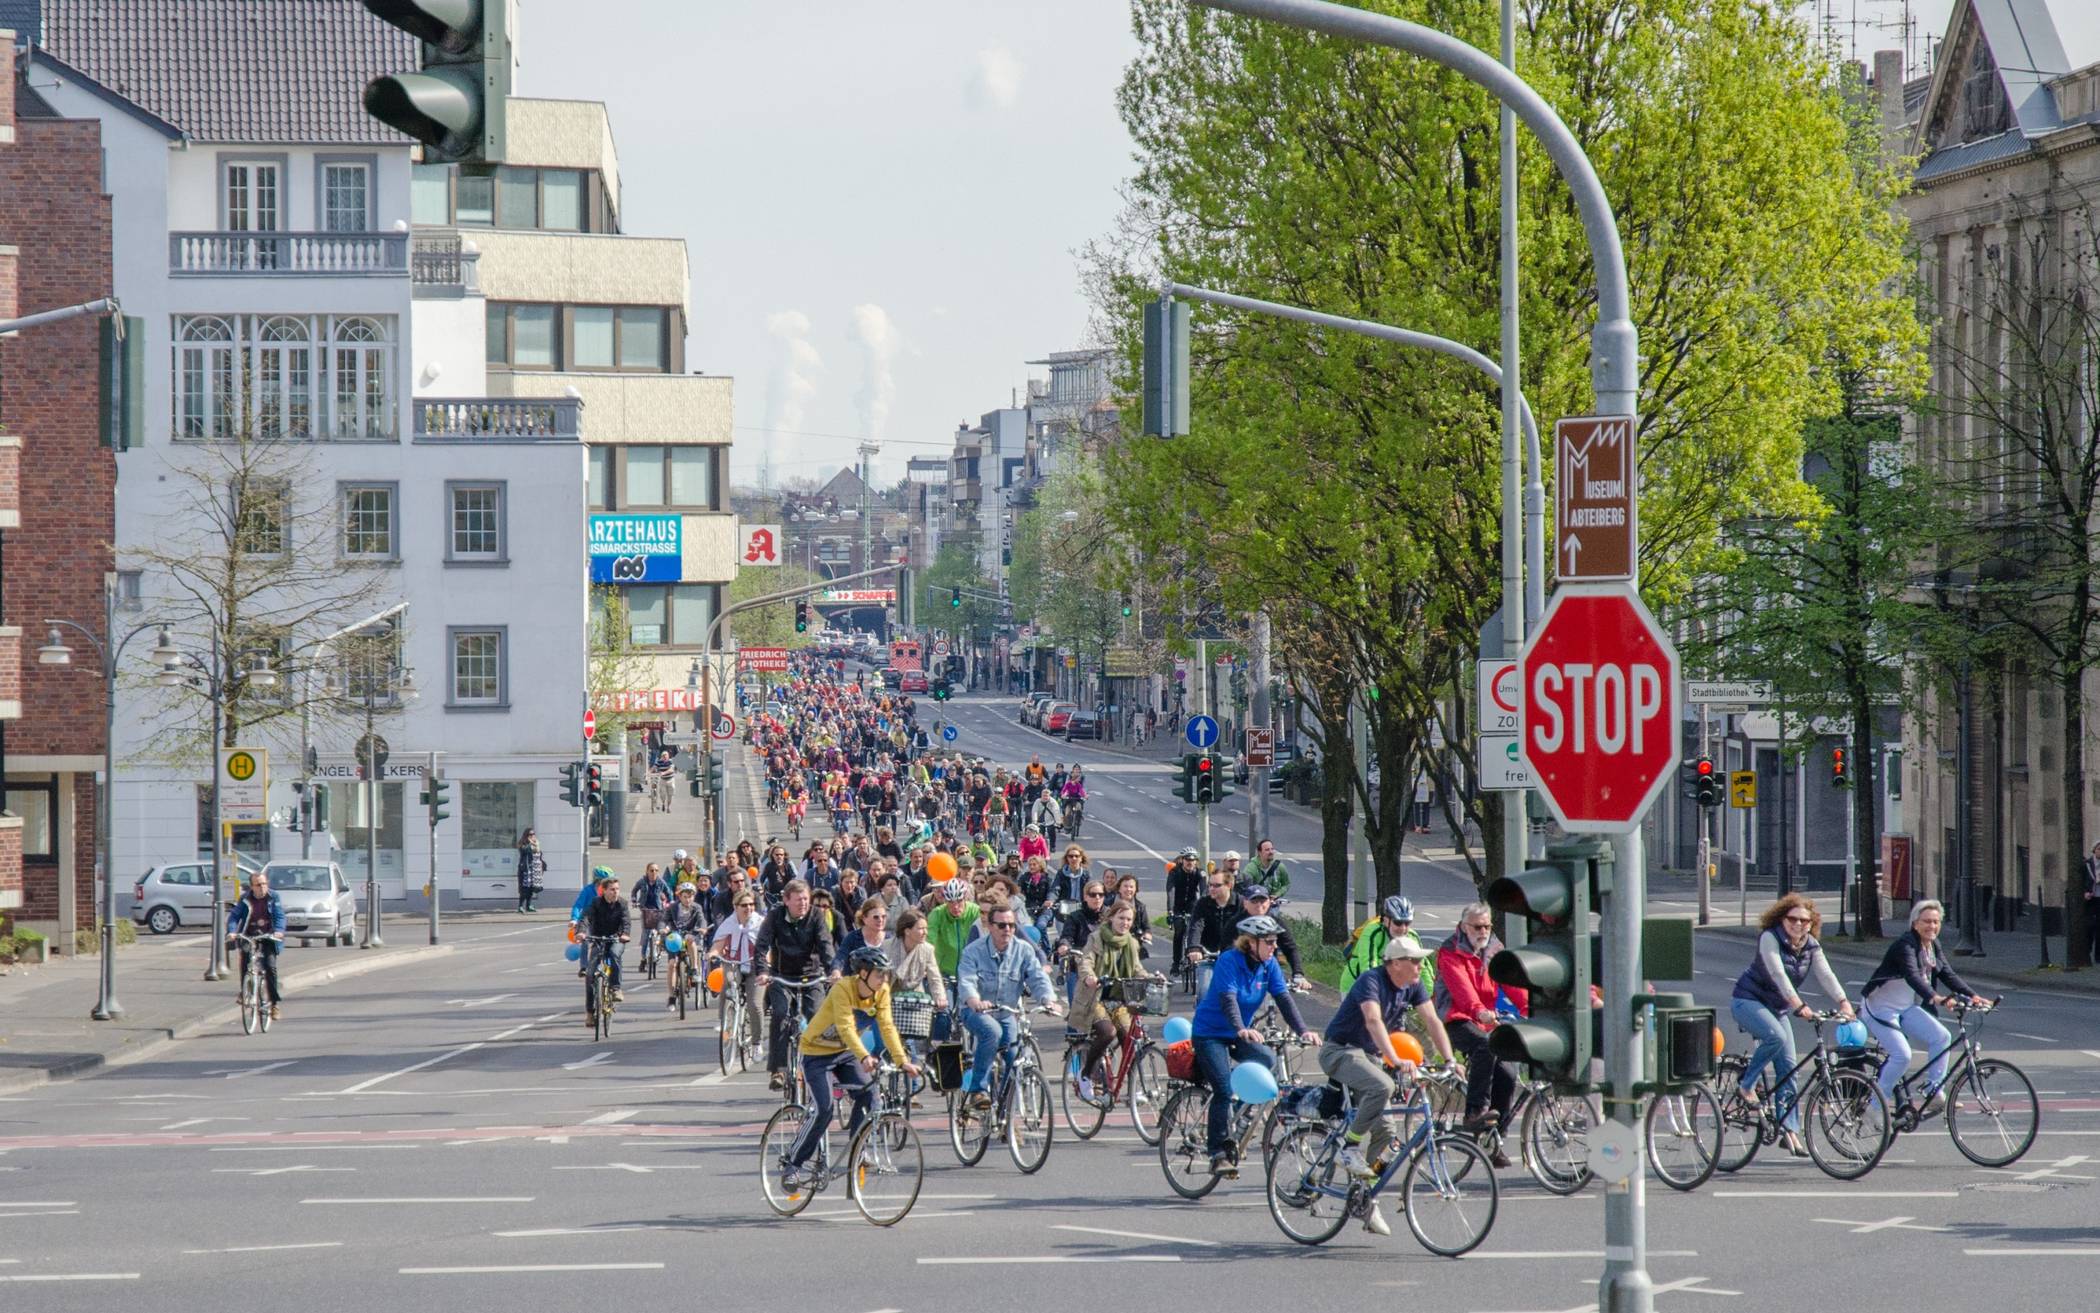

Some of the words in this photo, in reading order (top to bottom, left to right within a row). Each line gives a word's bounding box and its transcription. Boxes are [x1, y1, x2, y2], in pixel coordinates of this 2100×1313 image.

[1570, 507, 1625, 528] ABTEIBERG
[590, 543, 676, 554] ISMARCKSTRASSE
[740, 651, 786, 659] FRIEDRICH
[740, 660, 786, 668] AOTHEKE
[1692, 688, 1750, 697] Stadtbibliothek
[1534, 662, 1661, 755] STOP
[714, 720, 731, 734] 40
[1498, 716, 1518, 728] ZO
[235, 758, 247, 774] H
[314, 766, 353, 776] NGEL
[1505, 769, 1528, 782] frei
